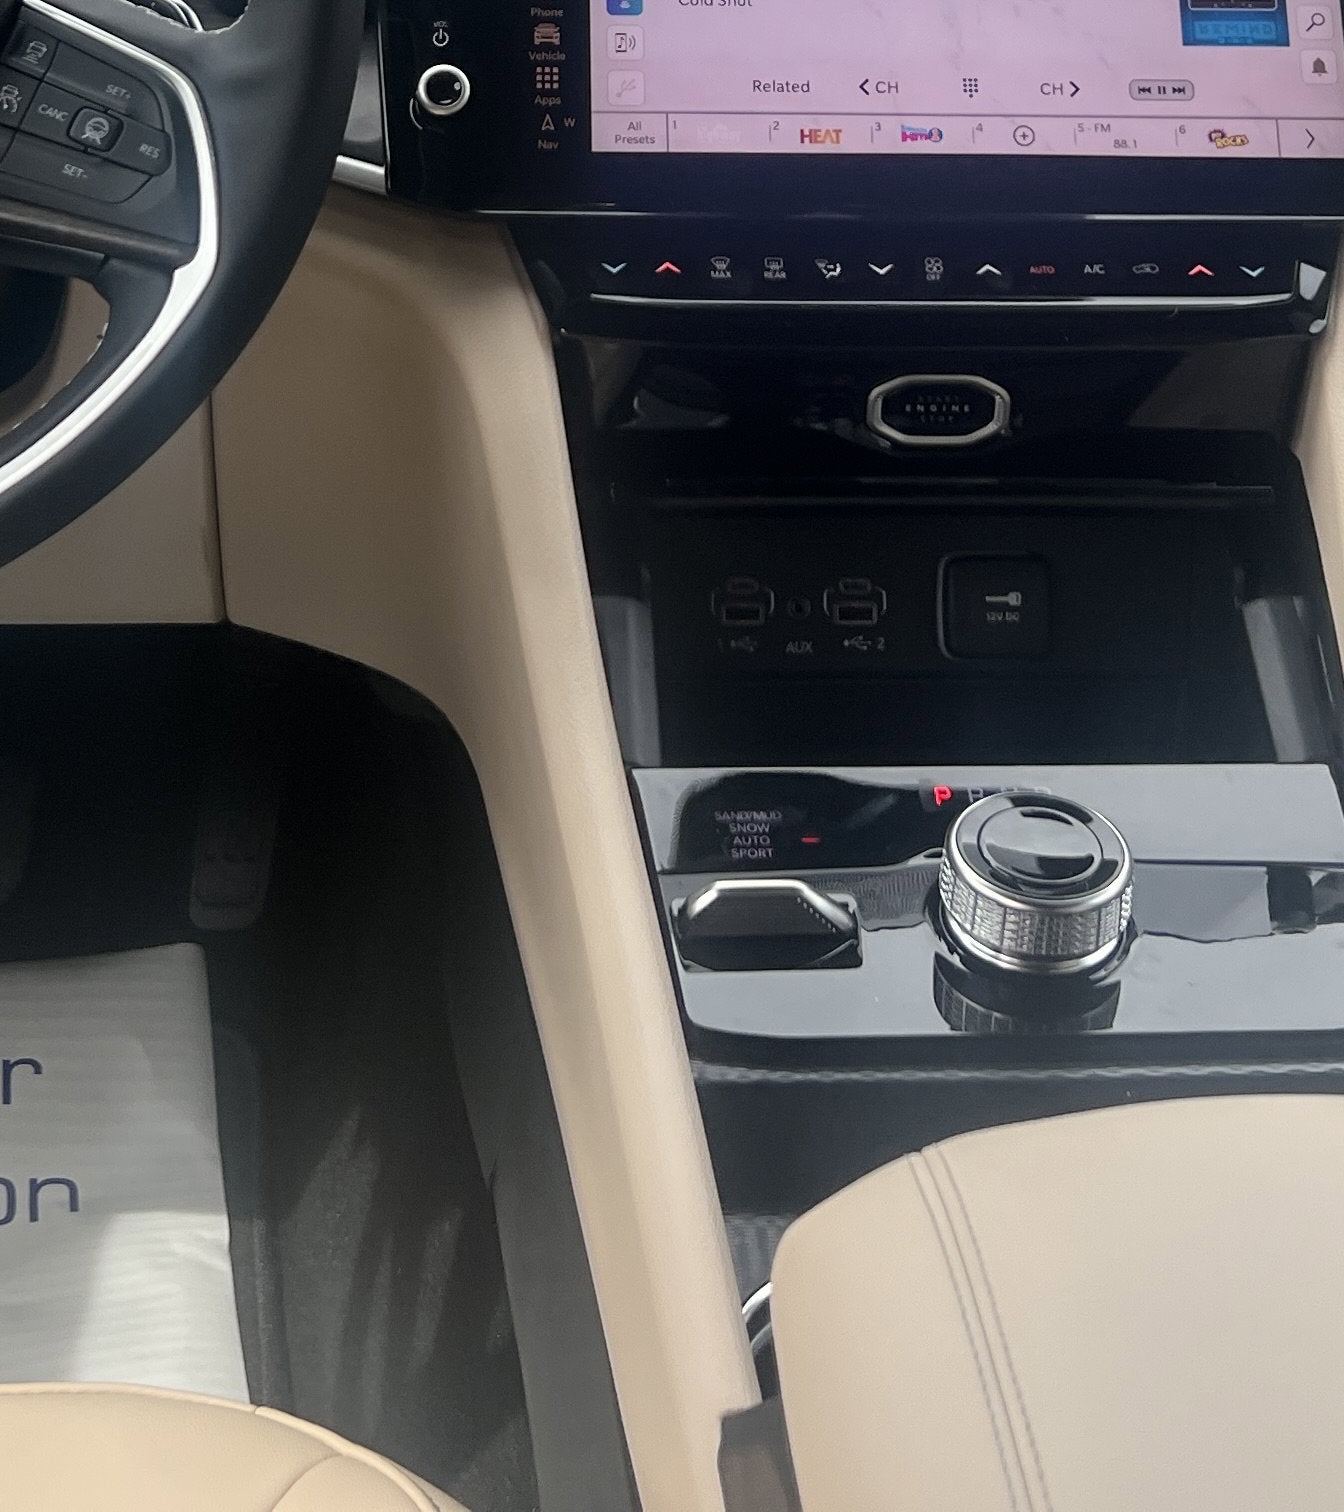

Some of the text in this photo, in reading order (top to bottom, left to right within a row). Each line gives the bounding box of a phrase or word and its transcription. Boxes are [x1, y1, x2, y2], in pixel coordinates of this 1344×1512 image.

[530, 6, 564, 17] Phone
[528, 50, 566, 61] Vehicle
[106, 83, 132, 101] SET+
[752, 79, 811, 94] Related
[875, 81, 899, 94] CH
[1040, 82, 1063, 96] CH
[534, 95, 561, 107] Apps
[38, 103, 69, 122] CANC
[563, 117, 576, 128] W
[627, 120, 643, 132] All
[773, 120, 781, 131] 2
[874, 123, 882, 133] 3
[975, 123, 984, 133] 4
[1077, 124, 1112, 134] 5 FM
[1178, 125, 1186, 135] 6
[614, 134, 656, 146] Presets
[799, 128, 843, 145] HEAT
[138, 142, 161, 159] RES
[537, 139, 559, 150] Nav
[1113, 139, 1138, 150] 88.1
[61, 163, 88, 179] SET-
[710, 270, 732, 279] MAX
[763, 270, 787, 279] REAR
[1029, 264, 1055, 274] AUTO
[1083, 264, 1106, 275] A/C
[904, 403, 971, 413] ENGINE
[785, 640, 814, 654] AUX
[876, 637, 886, 651] 2
[933, 785, 952, 807] P
[714, 810, 784, 822] SAND/MUD
[728, 822, 770, 834] SNOW
[733, 835, 771, 847] AUTO
[731, 847, 774, 860] SPORT
